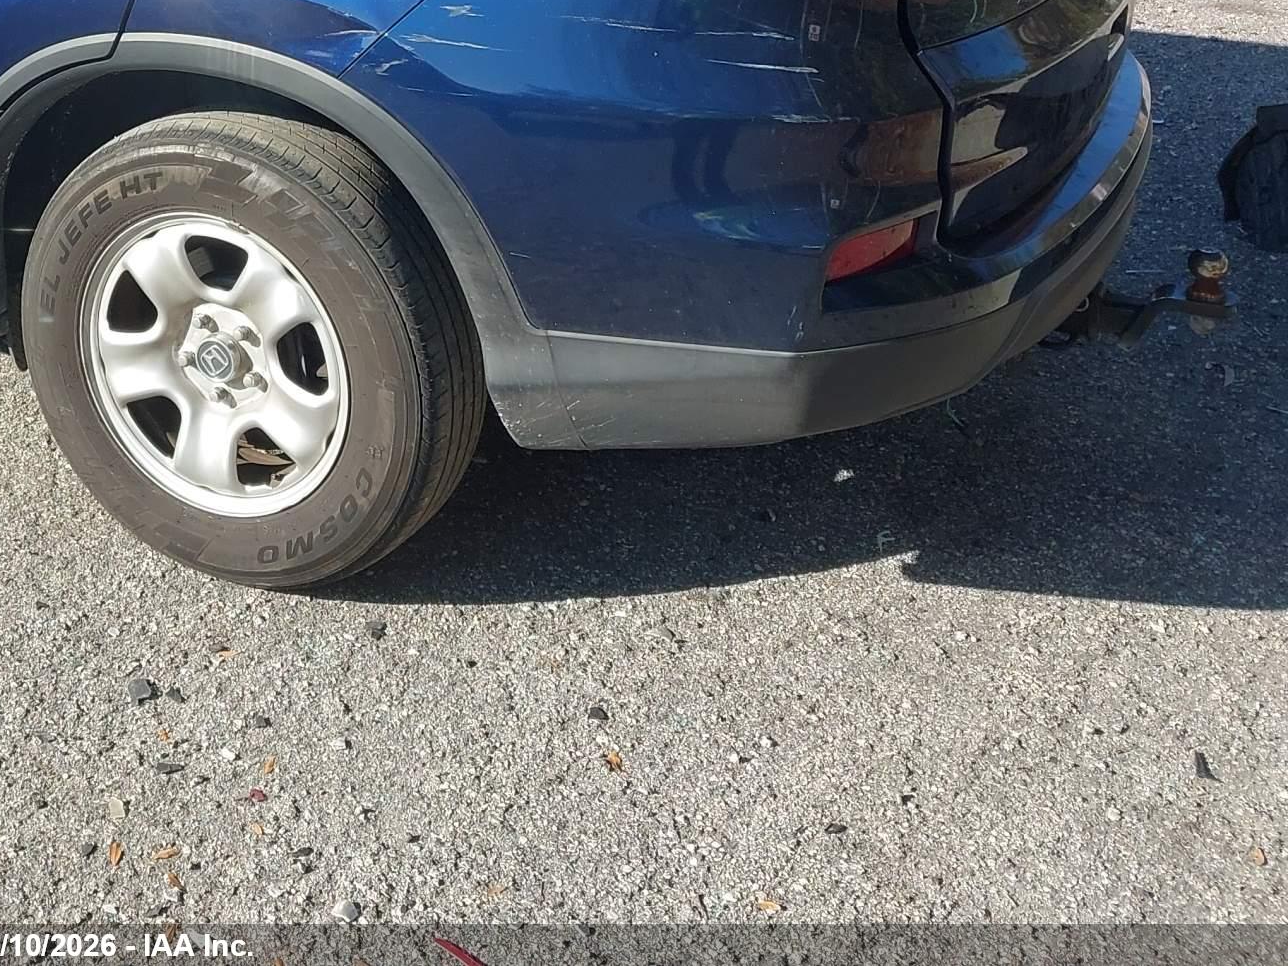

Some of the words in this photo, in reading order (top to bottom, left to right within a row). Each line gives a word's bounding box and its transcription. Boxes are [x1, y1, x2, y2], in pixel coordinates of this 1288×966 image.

[40, 274, 61, 315] EL
[58, 189, 113, 265] JEFE
[119, 171, 163, 200] HT
[257, 467, 373, 564] COSMO
